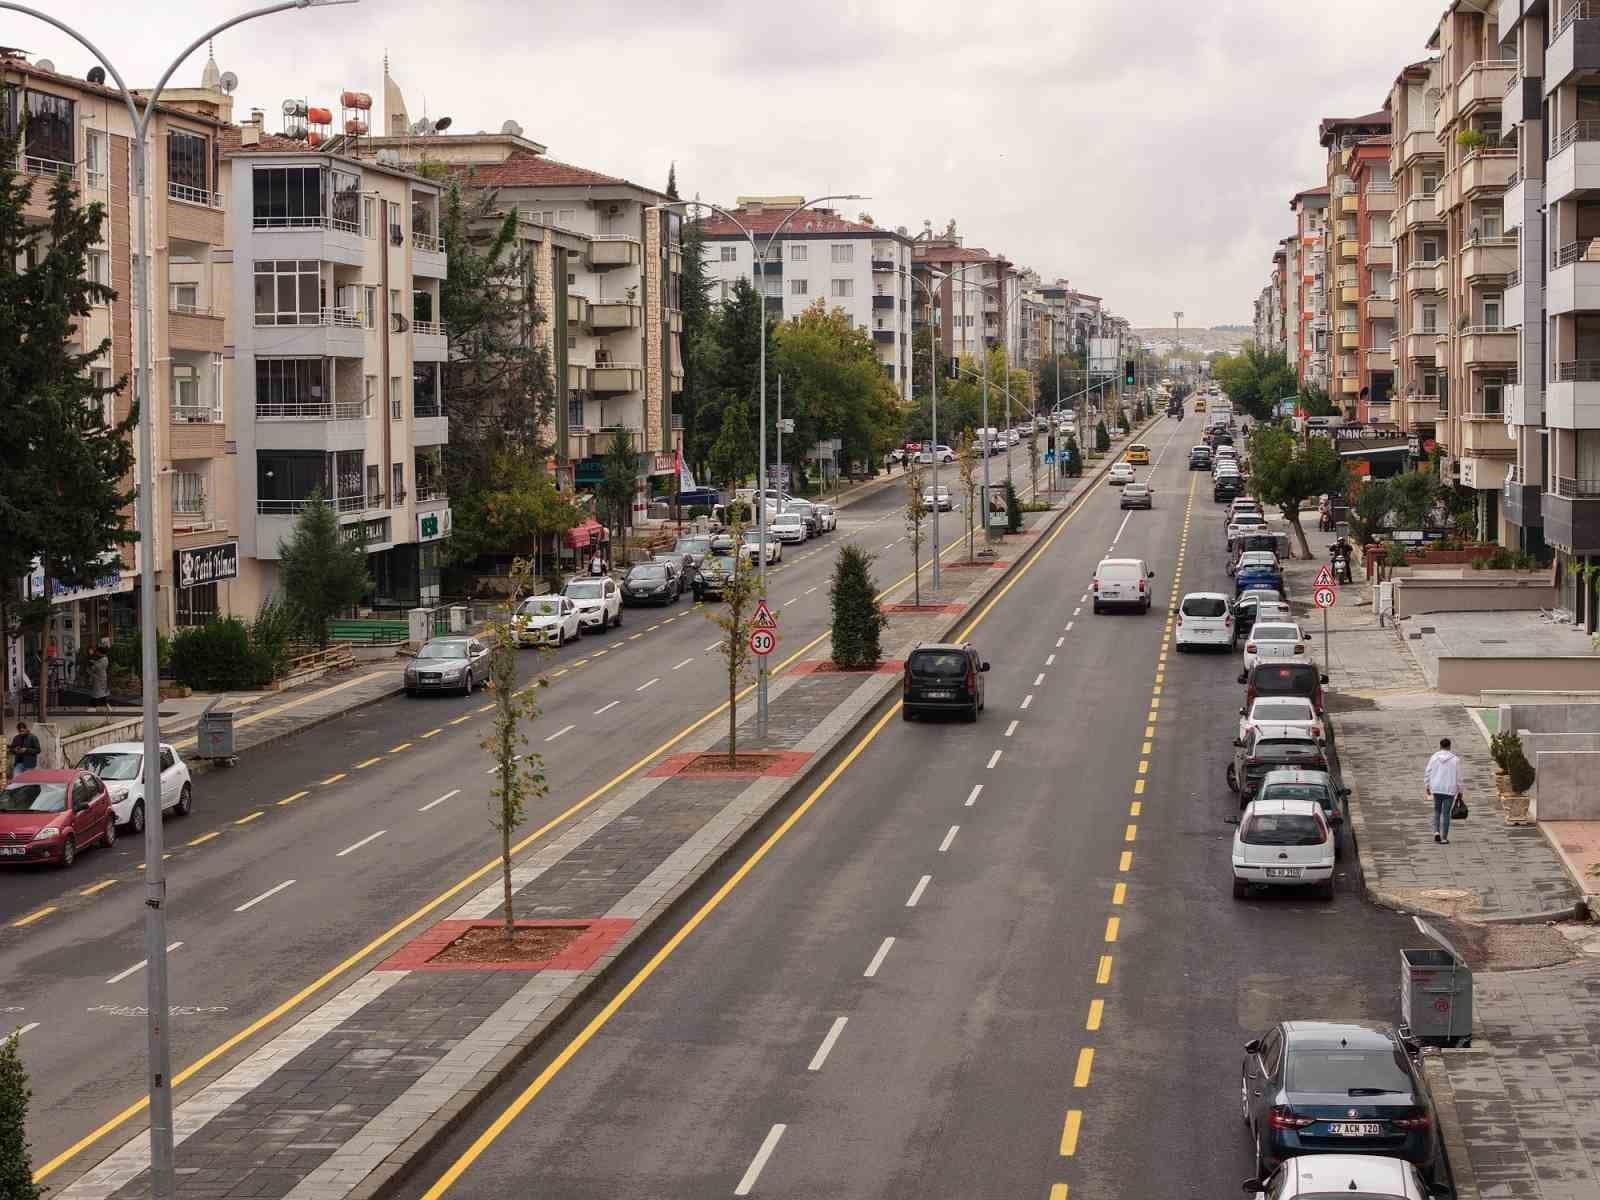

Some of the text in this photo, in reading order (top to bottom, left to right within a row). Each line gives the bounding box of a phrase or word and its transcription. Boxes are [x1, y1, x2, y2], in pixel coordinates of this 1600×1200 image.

[194, 551, 212, 581] Fatih
[1318, 592, 1332, 603] 30
[755, 636, 771, 648] 30
[1332, 1124, 1342, 1133] 27
[1363, 1124, 1378, 1133] 120
